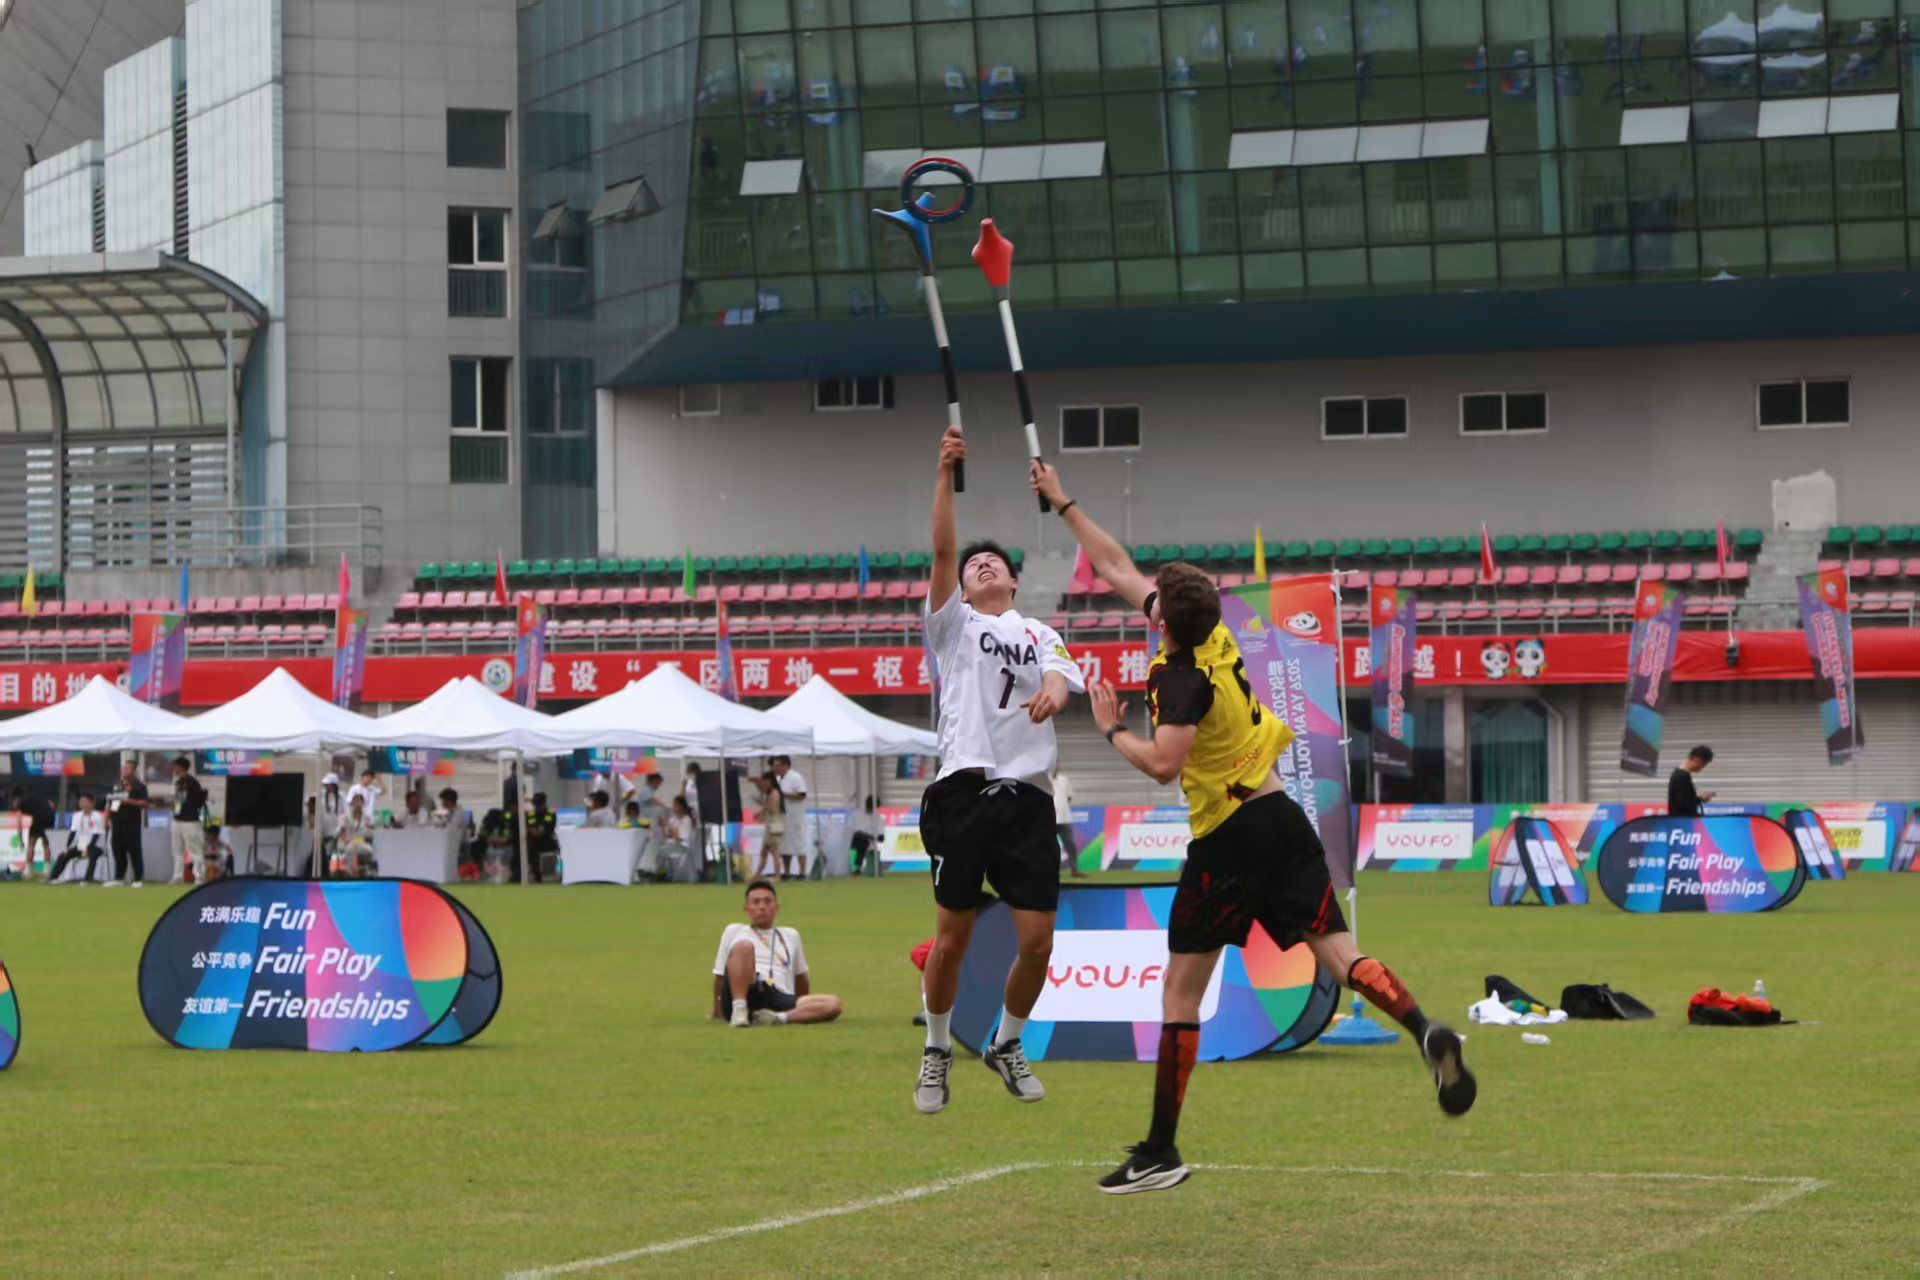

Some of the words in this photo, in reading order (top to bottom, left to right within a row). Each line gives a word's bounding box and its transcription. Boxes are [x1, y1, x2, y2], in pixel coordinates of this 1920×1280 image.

[999, 667, 1015, 709] 7
[1669, 829, 1702, 845] Fun
[934, 855, 944, 886] 7
[1667, 853, 1703, 870] Fair
[1705, 853, 1744, 873] Play
[1666, 878, 1766, 898] Friendships
[263, 902, 316, 930] Fun
[192, 951, 252, 969] 公平竞争
[255, 946, 313, 974] Fair
[317, 947, 381, 981] Play
[1047, 964, 1168, 988] YOU·F
[182, 997, 244, 1014] 友谊第一
[246, 990, 410, 1025] Friendships
